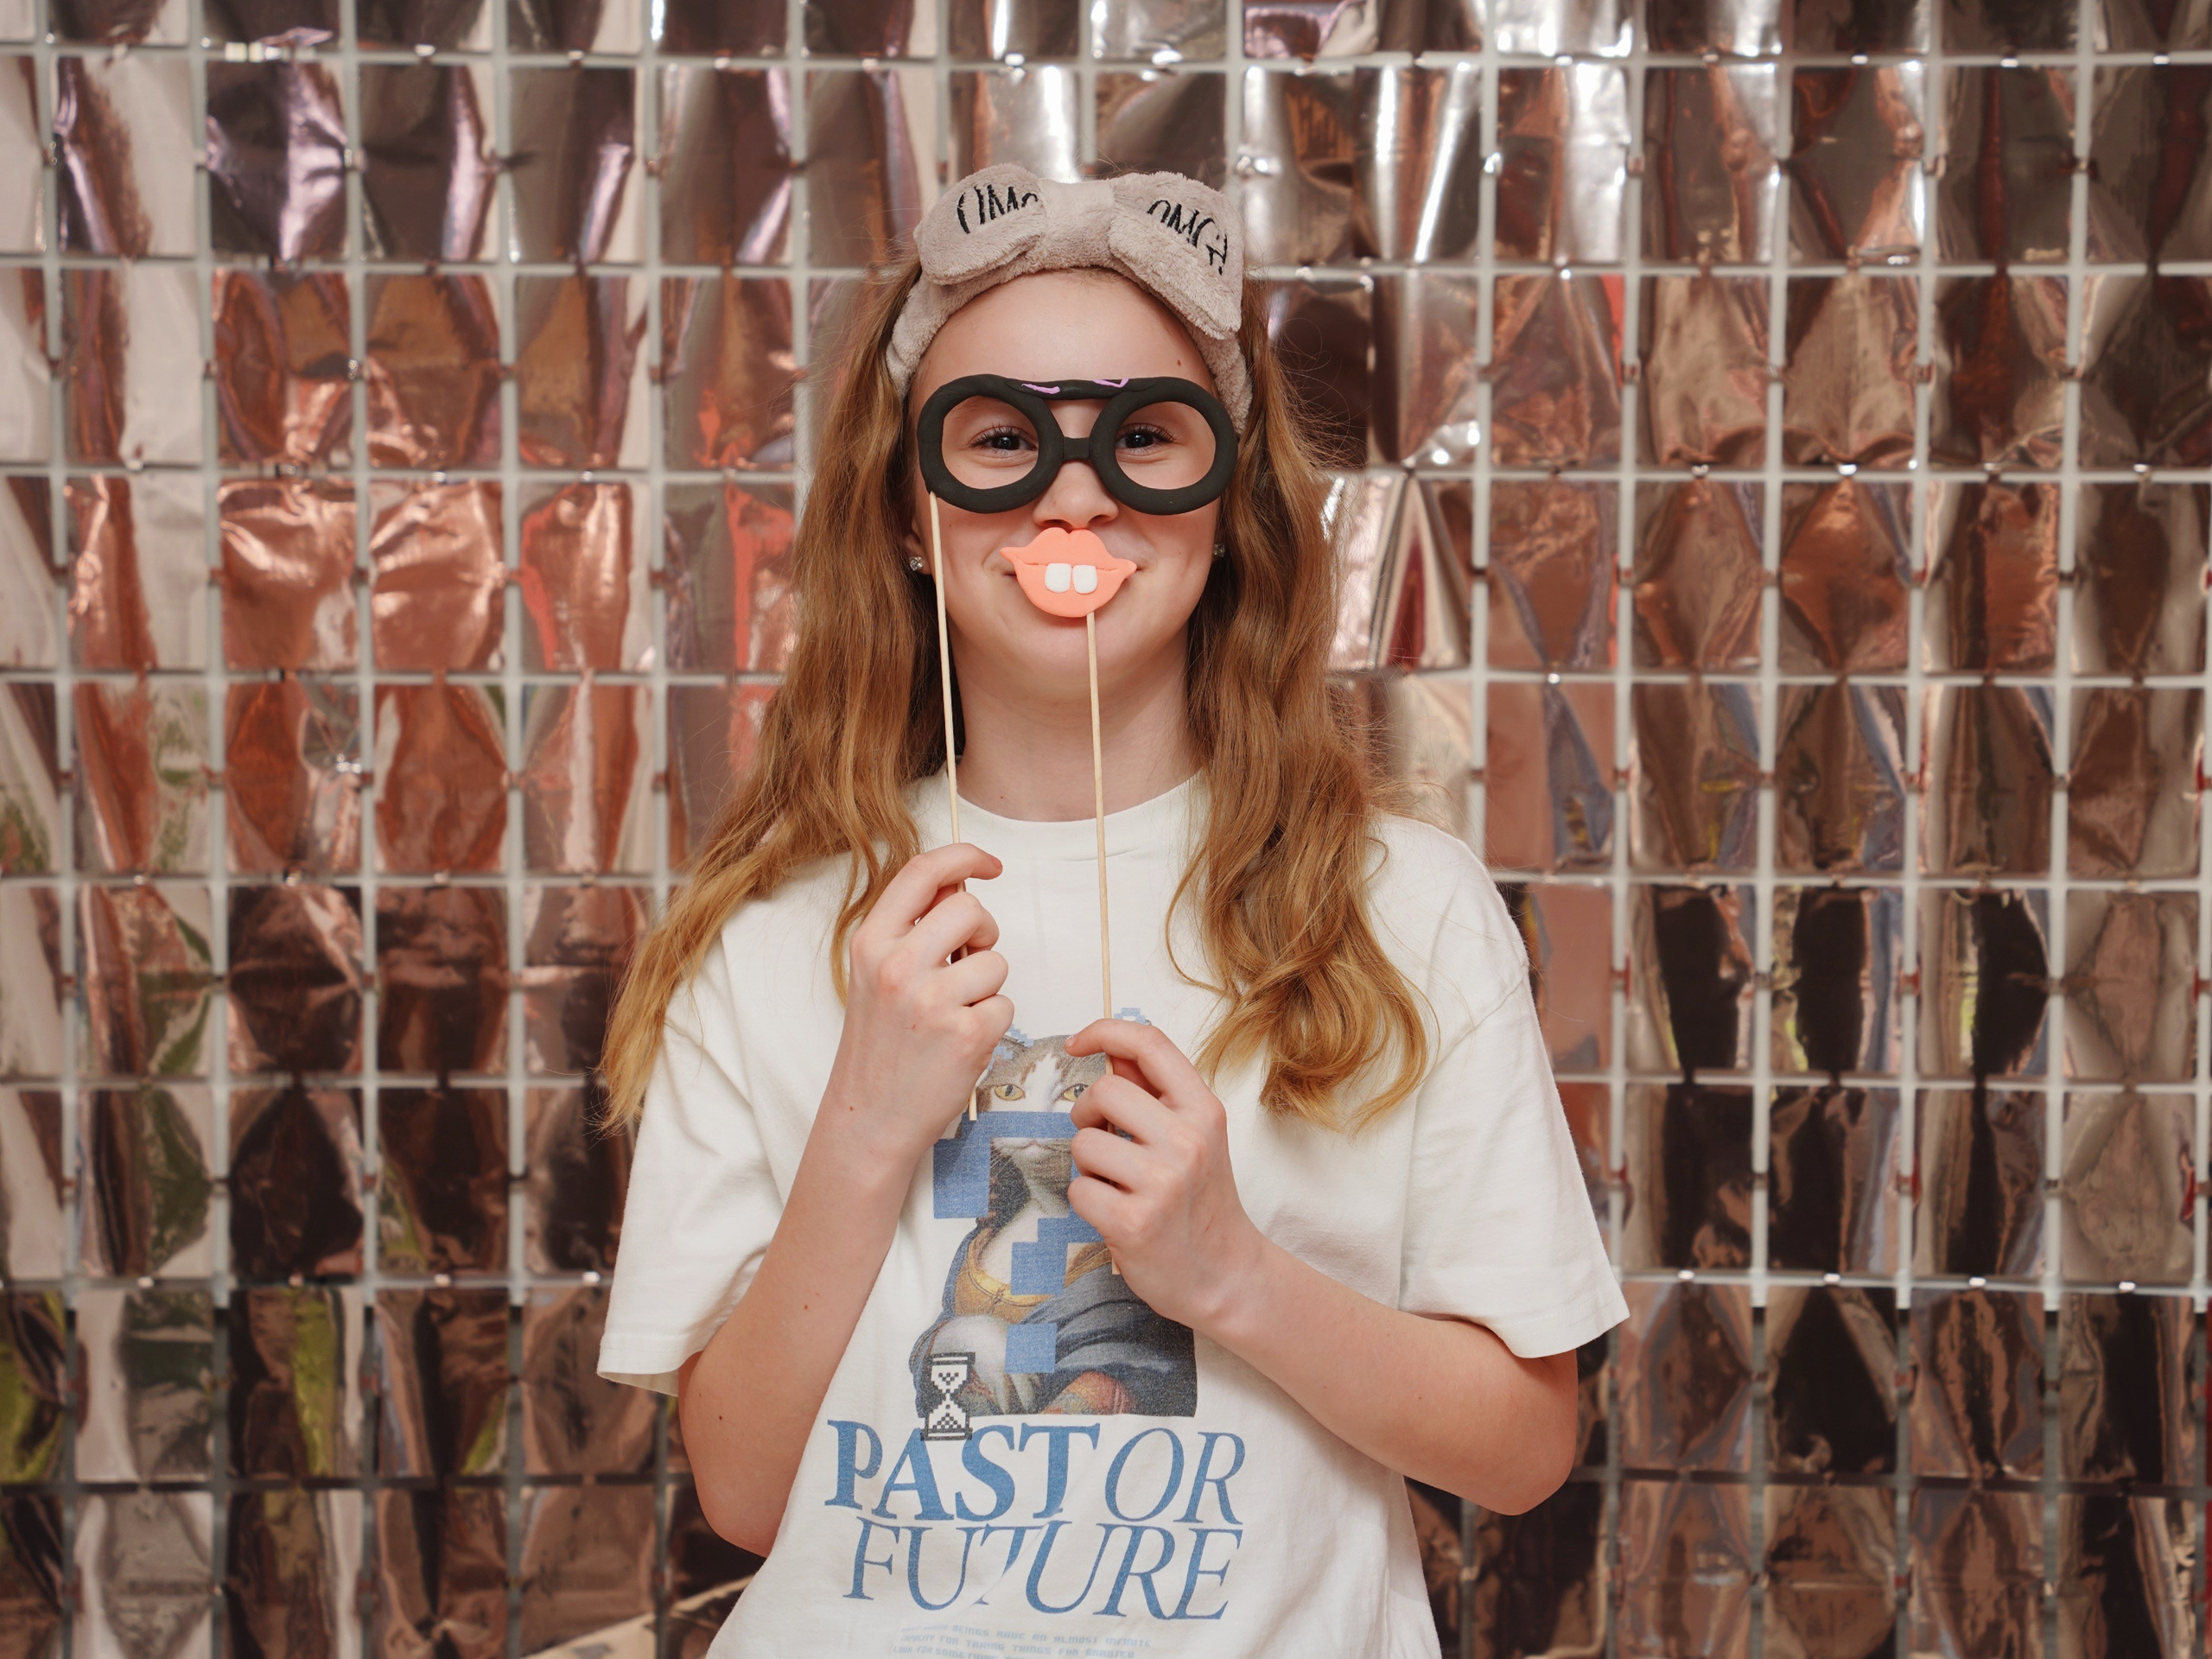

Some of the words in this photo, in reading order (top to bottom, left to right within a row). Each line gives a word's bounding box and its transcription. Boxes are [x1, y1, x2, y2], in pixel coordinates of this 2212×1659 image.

[824, 1419, 1100, 1521] PAST
[1104, 1427, 1246, 1524] OR
[842, 1516, 1243, 1620] FUTURE
